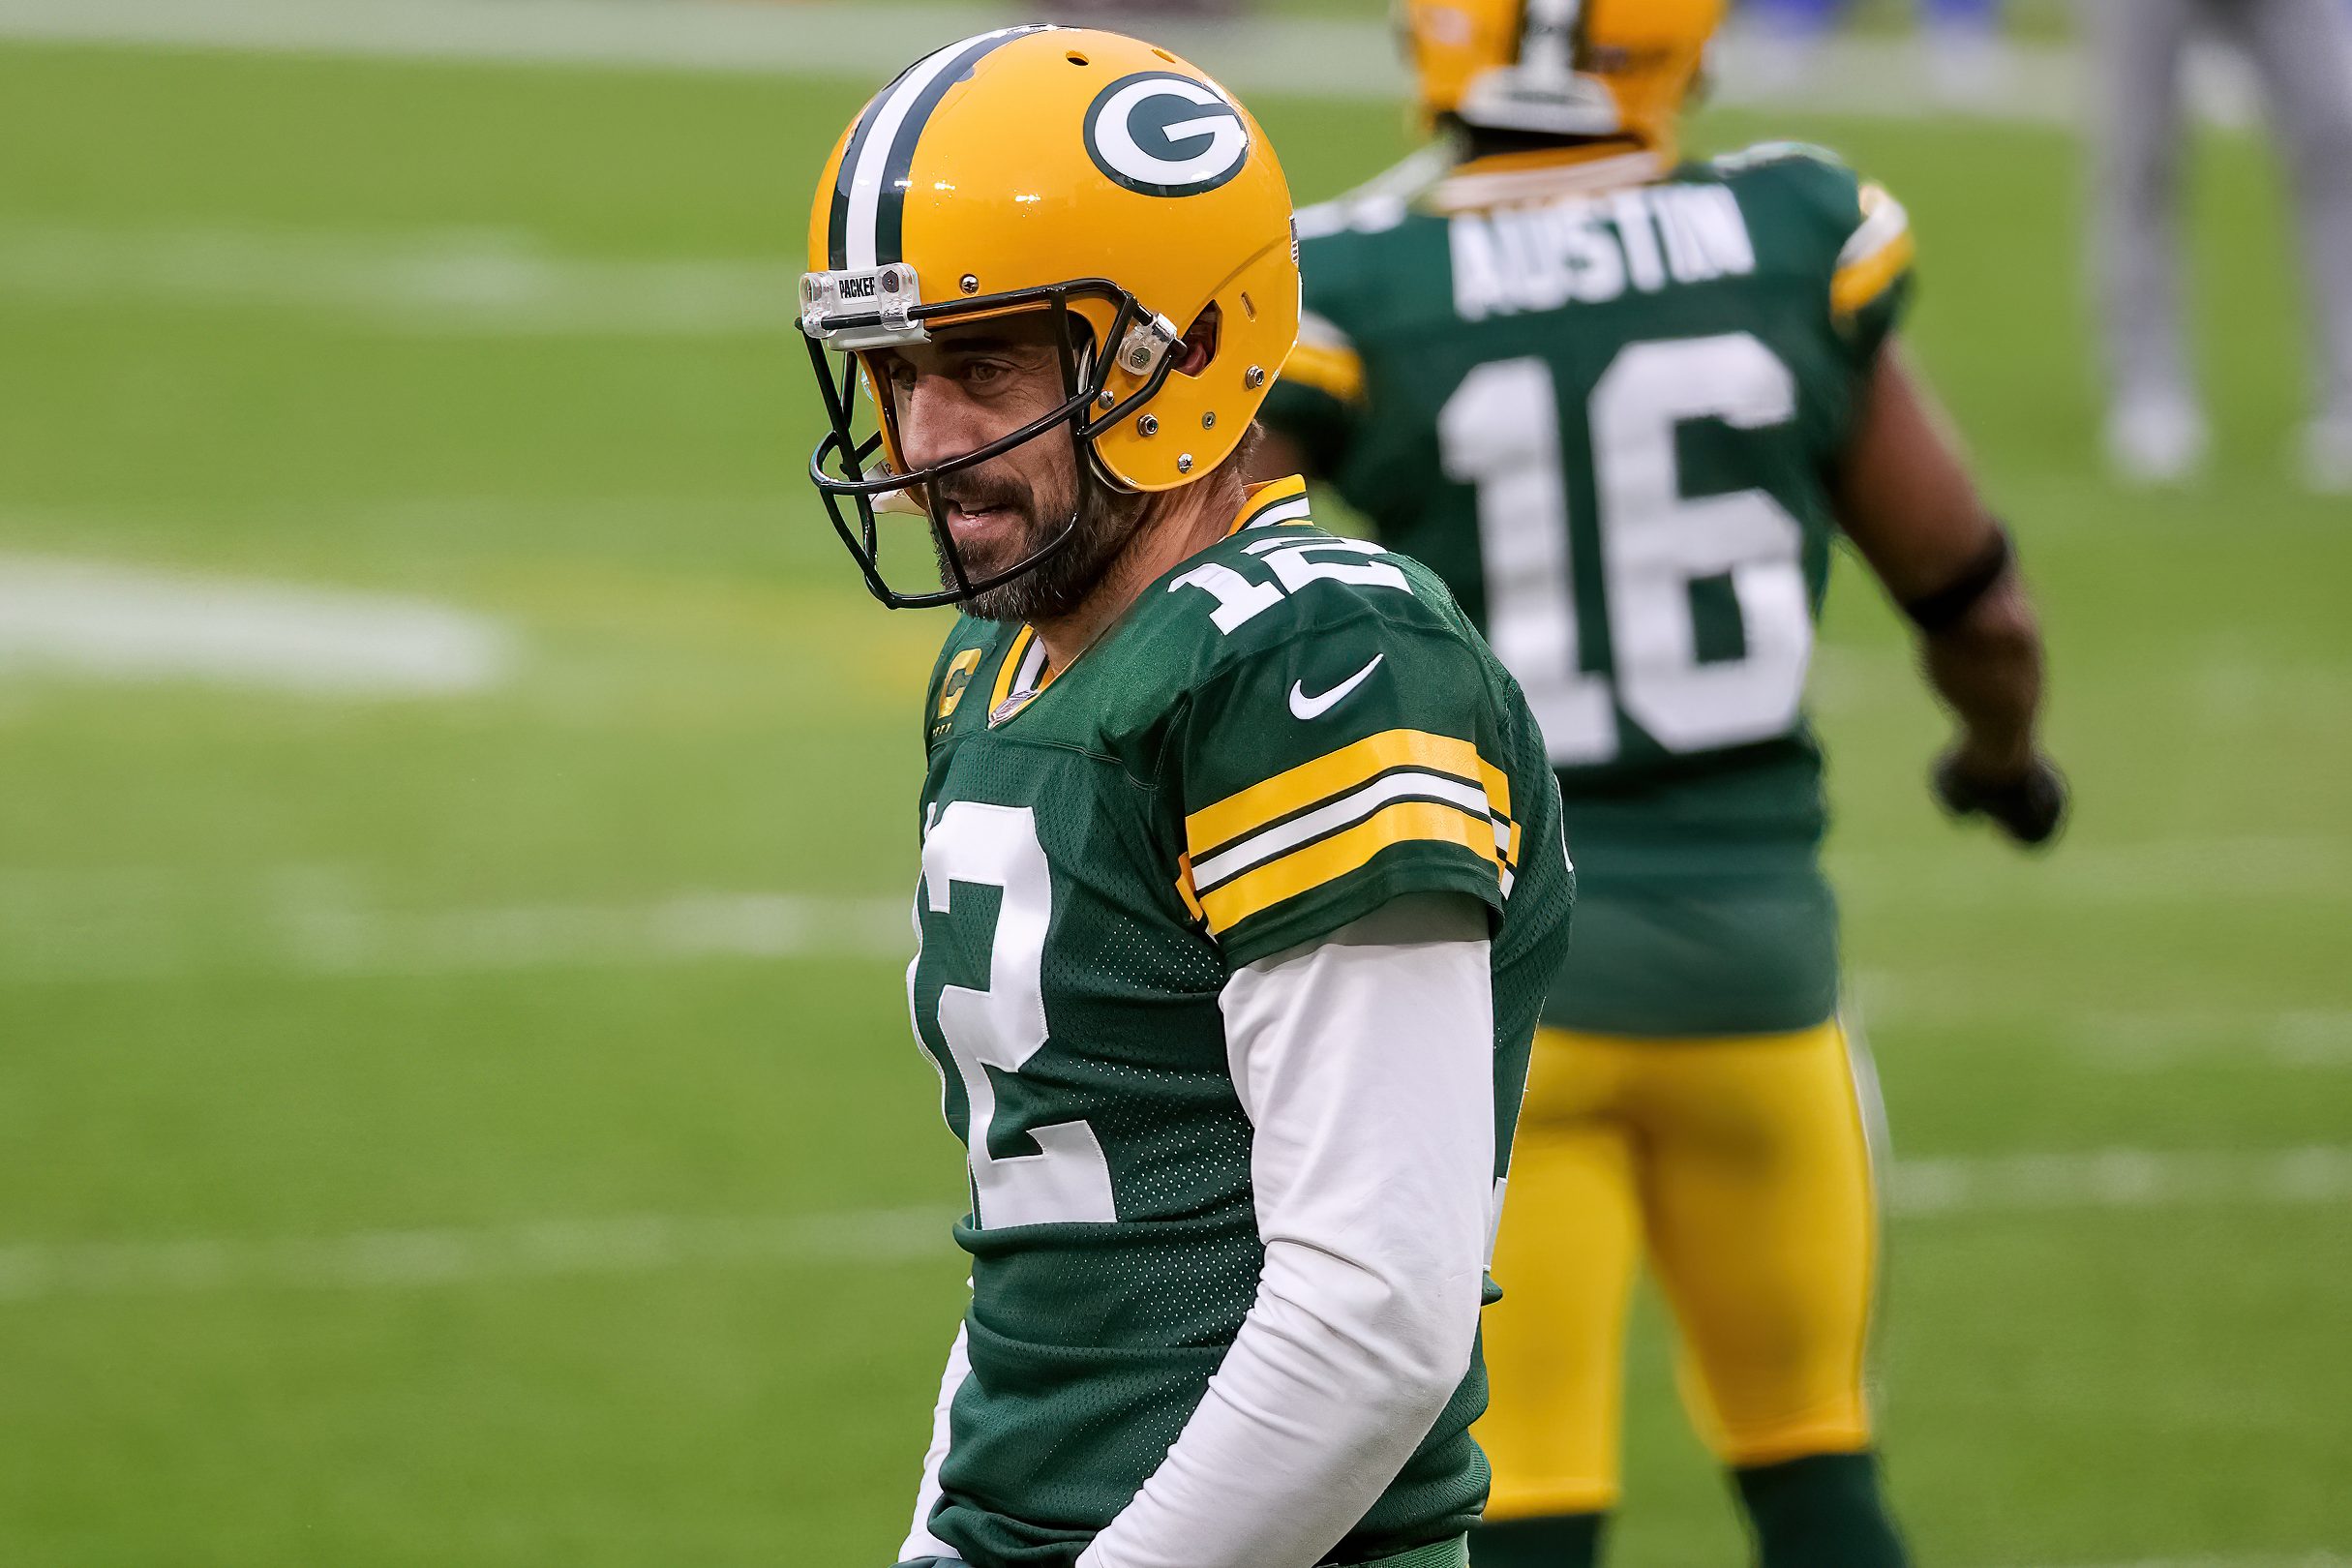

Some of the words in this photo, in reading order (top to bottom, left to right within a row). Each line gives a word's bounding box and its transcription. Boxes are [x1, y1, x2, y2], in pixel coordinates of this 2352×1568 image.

[1094, 78, 1247, 186] G
[1449, 183, 1755, 322] AUSTIN
[1166, 536, 1415, 636] 12
[1436, 330, 1814, 766] 16
[937, 648, 982, 719] C
[906, 800, 1118, 1231] 2
